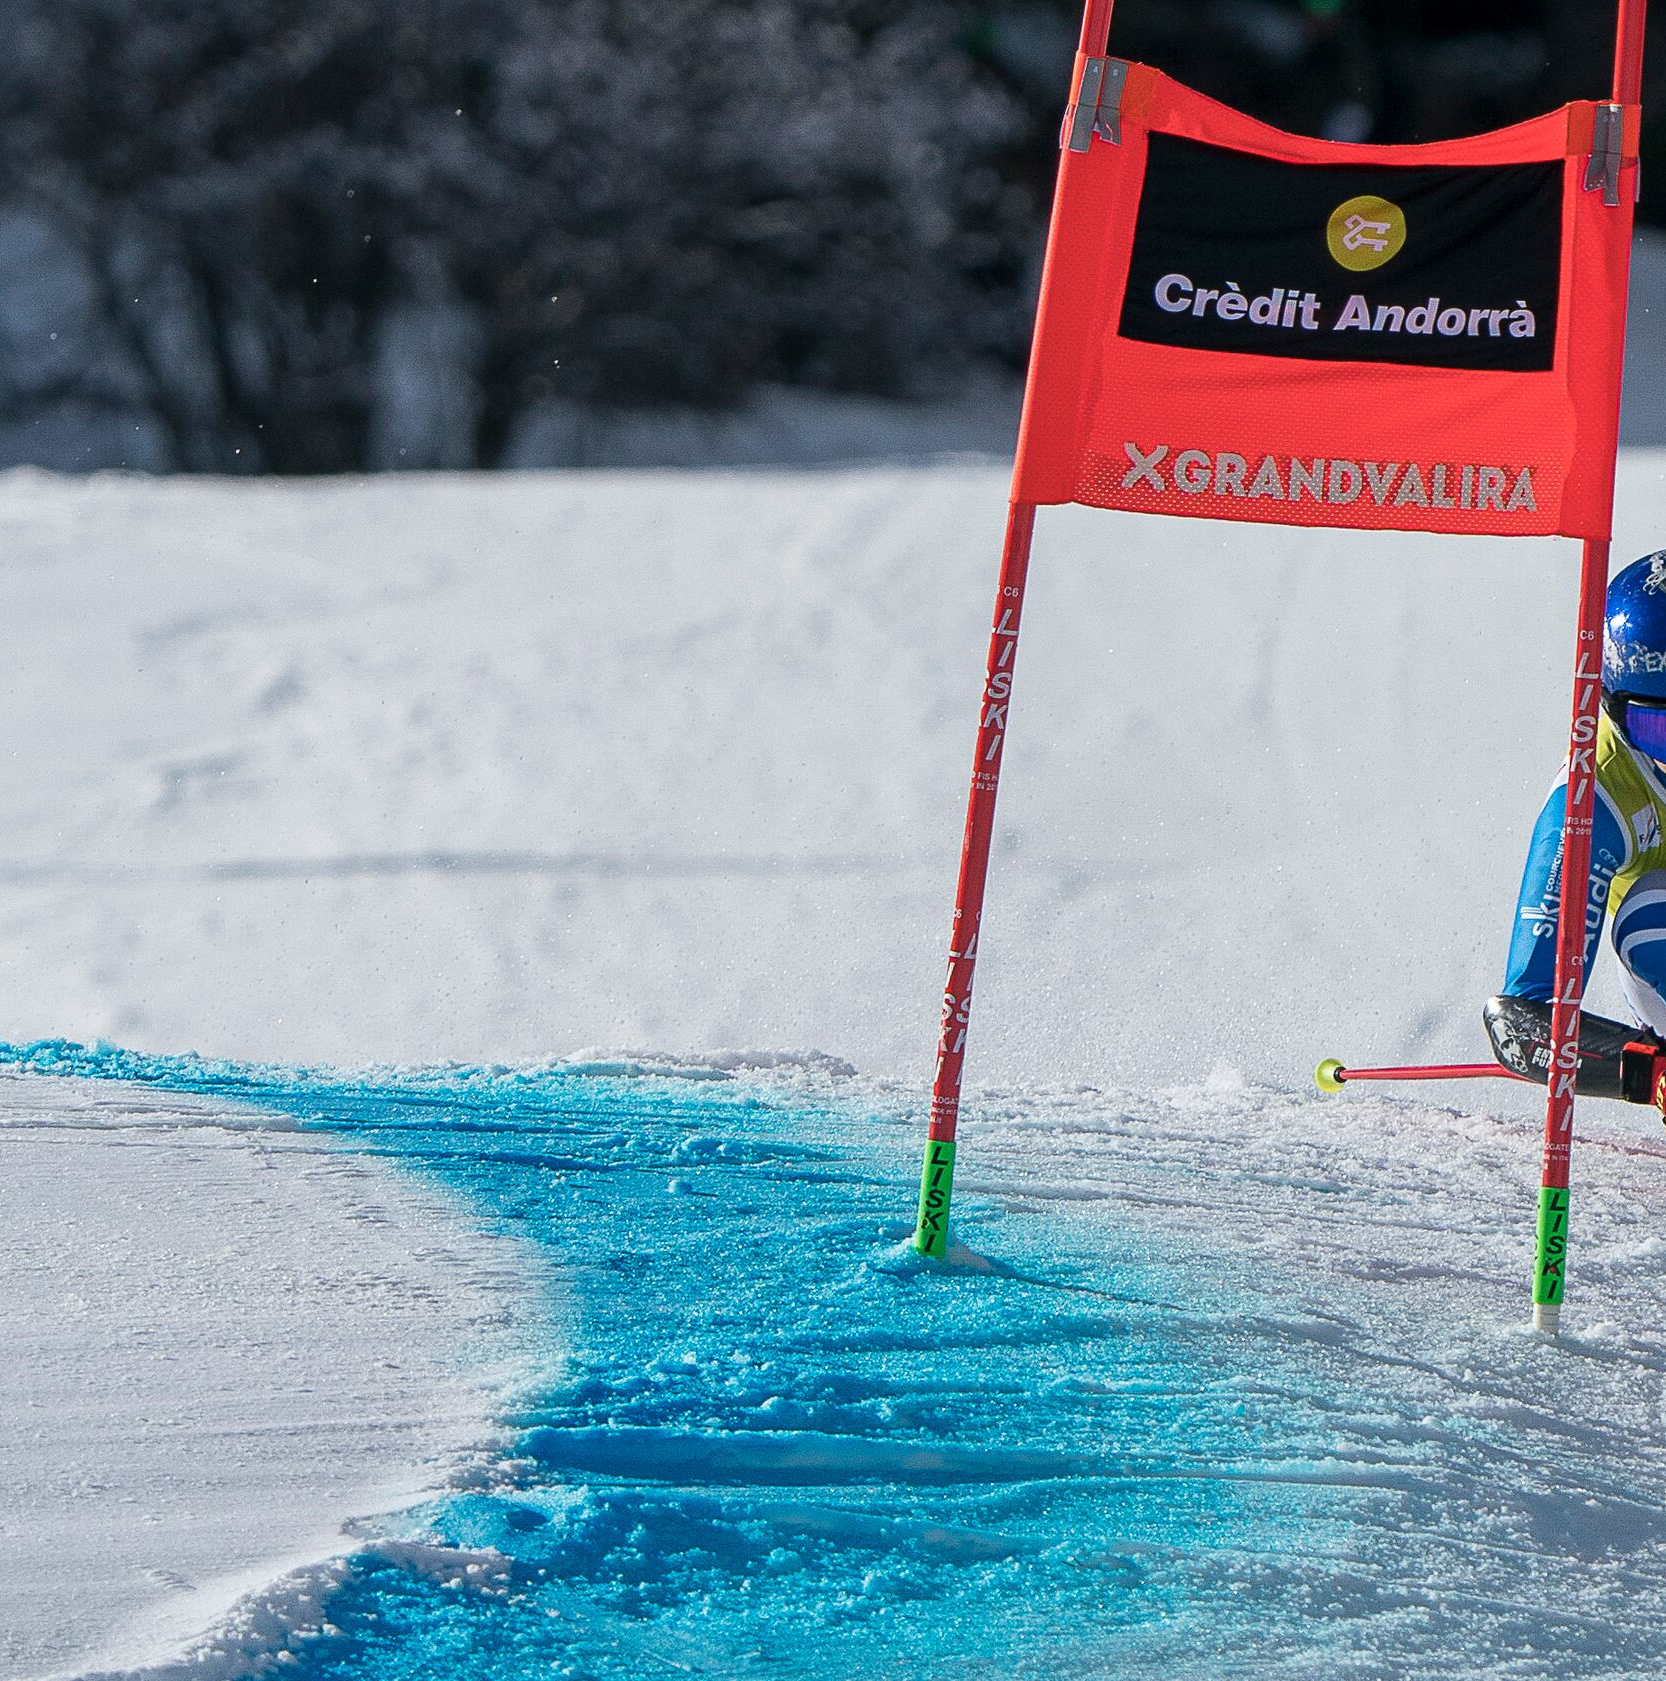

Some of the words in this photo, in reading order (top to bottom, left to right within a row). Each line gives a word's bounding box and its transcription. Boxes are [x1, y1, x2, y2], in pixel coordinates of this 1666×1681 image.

[1153, 272, 1321, 331] Crèdit
[1332, 293, 1537, 339] Andorrà
[1173, 449, 1539, 513] GRANDVALIRA
[1571, 652, 1599, 806] LISKI
[1555, 977, 1581, 1131] LISKI
[921, 1146, 949, 1252] LISKI
[1542, 1193, 1566, 1299] LISKI
